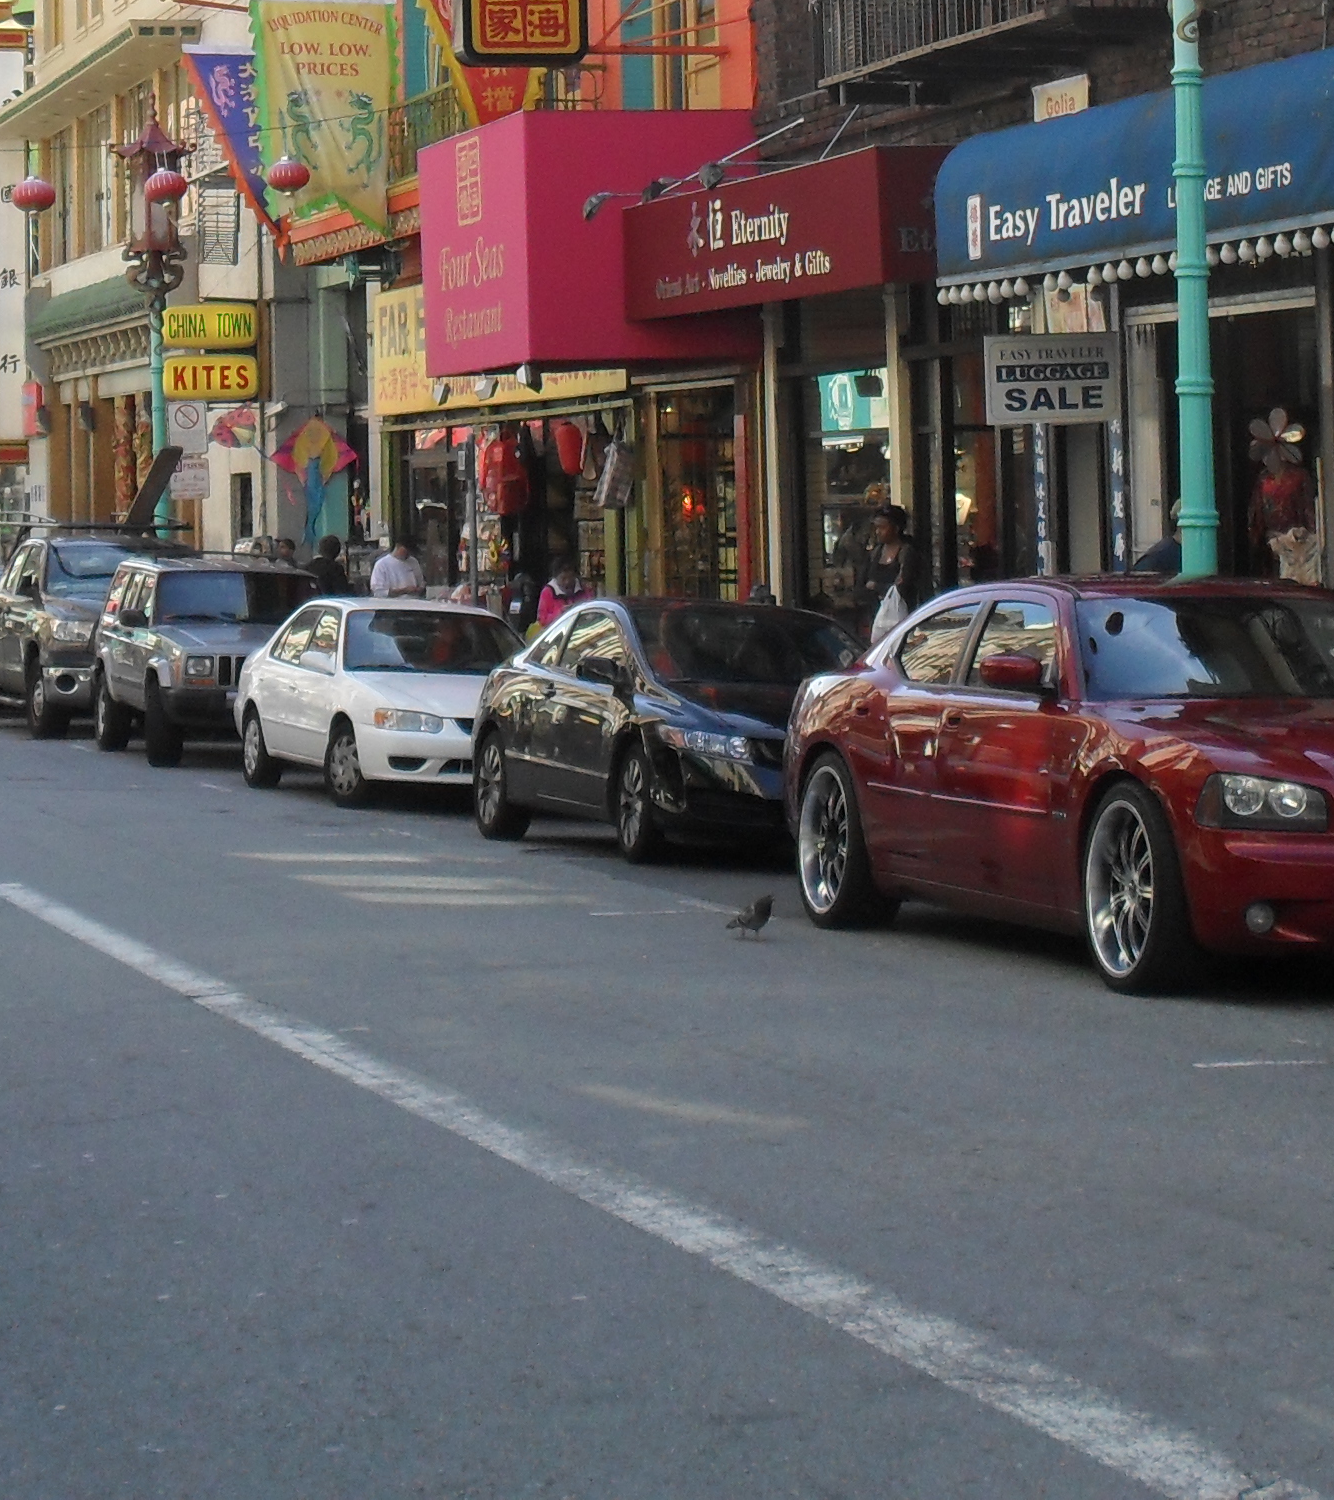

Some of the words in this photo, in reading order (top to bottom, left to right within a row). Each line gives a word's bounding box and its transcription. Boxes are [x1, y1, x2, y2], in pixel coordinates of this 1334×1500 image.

[267, 10, 338, 33] LIQUIDATION
[341, 11, 384, 37] CENTER
[296, 62, 359, 77] PRICES
[1226, 171, 1251, 197] AND
[1255, 162, 1292, 191] GIFTS
[731, 203, 789, 246] Eternity
[988, 203, 1039, 246] Easy
[1045, 176, 1146, 233] Traveler
[439, 246, 471, 292] Four
[473, 236, 505, 288] Seas
[708, 262, 747, 291] Novelties
[755, 257, 791, 285] Jewelry
[794, 252, 803, 278] &
[804, 250, 831, 276] Gifts
[168, 312, 207, 339] CHINA
[216, 312, 252, 339] TOWN
[379, 301, 409, 359] FAR
[445, 302, 504, 349] Restaurant
[1000, 348, 1033, 361] EASY
[1038, 346, 1104, 360] TRAVELER
[172, 365, 249, 390] KITES
[1000, 365, 1107, 382] LUGGAGE
[1004, 385, 1104, 412] SALE
